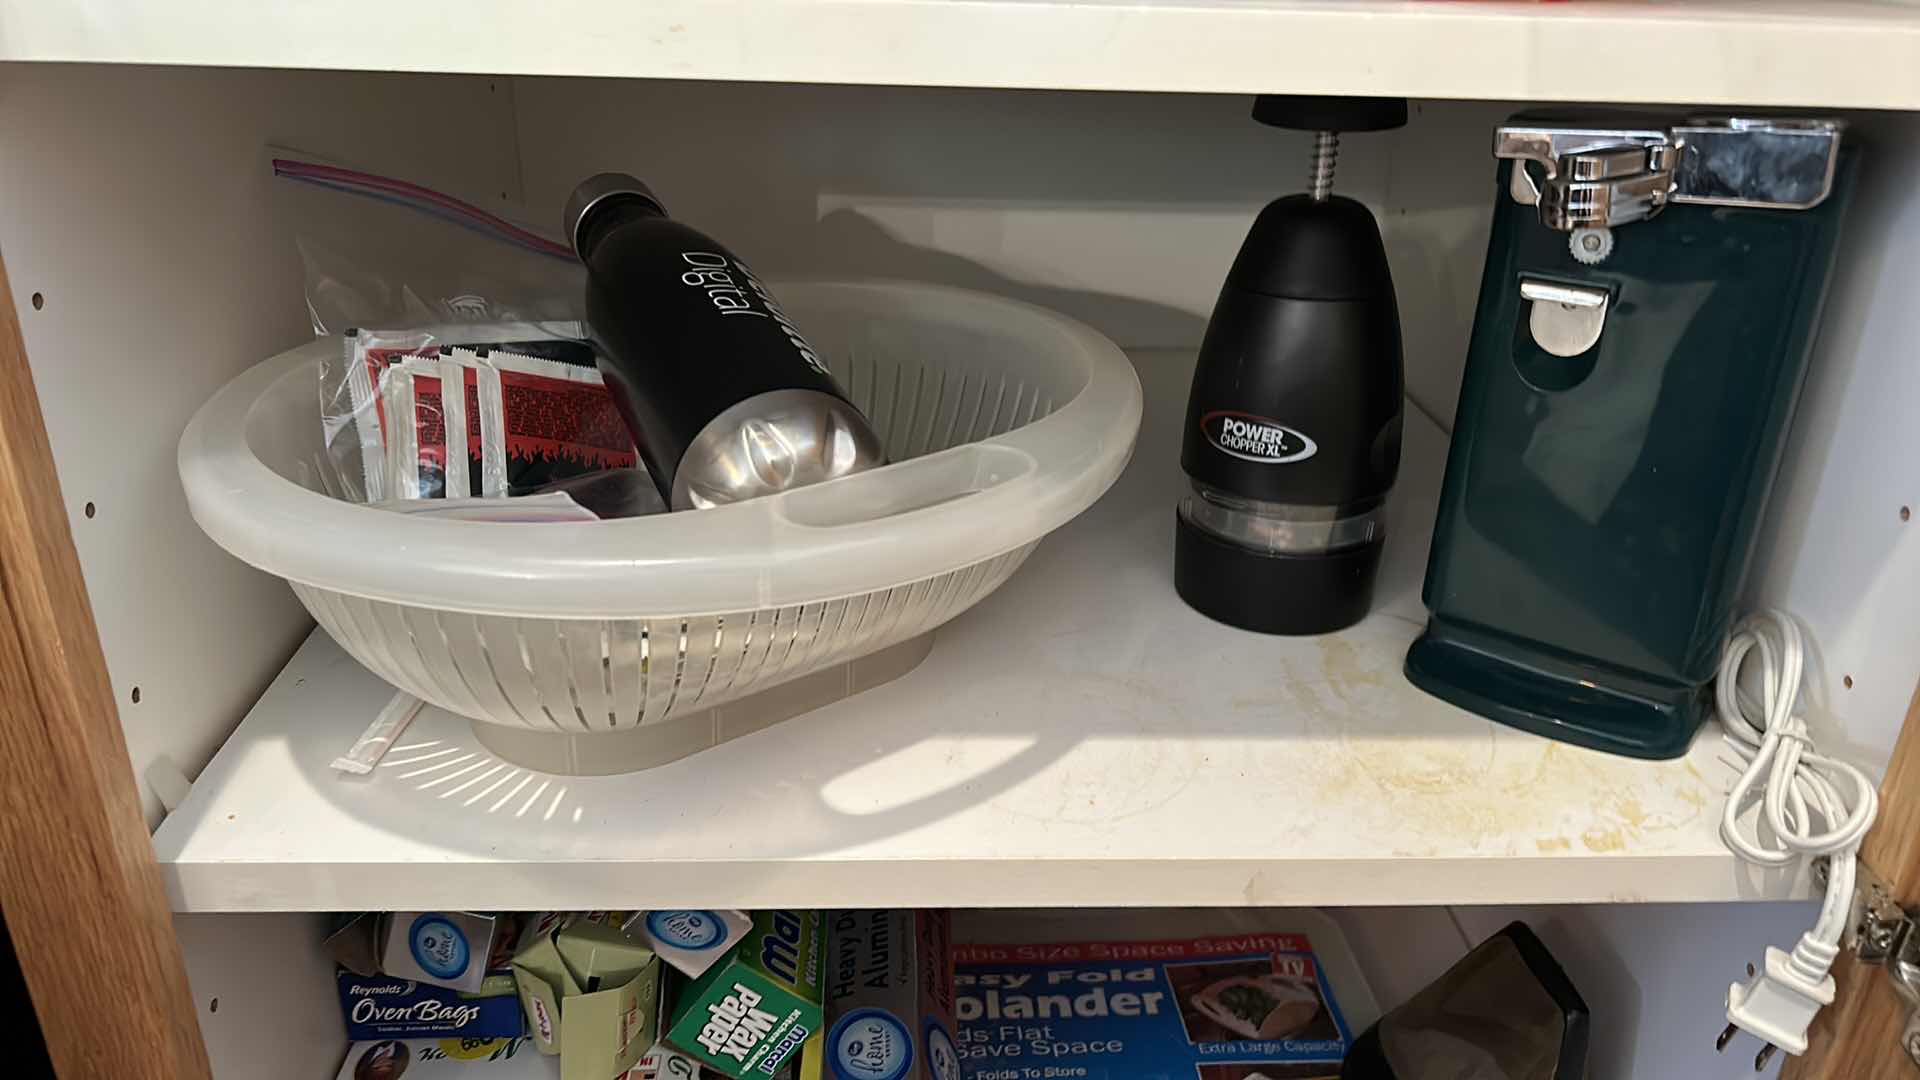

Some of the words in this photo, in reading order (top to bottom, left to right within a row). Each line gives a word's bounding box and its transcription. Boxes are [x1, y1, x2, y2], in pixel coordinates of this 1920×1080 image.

[681, 251, 769, 318] Digital
[1220, 432, 1266, 456] CHOPPER
[1222, 416, 1284, 445] POWER
[759, 911, 801, 986] Mar
[862, 910, 889, 988] Alumin
[1016, 945, 1081, 961] Size
[1089, 943, 1185, 962] Space
[835, 936, 862, 1000] Heavy
[954, 972, 1033, 990] asy
[1047, 968, 1156, 986] Fold
[349, 983, 403, 998] Reynolds
[954, 987, 1165, 1020] olander
[351, 997, 413, 1024] Oven
[413, 999, 481, 1028] Bags
[696, 982, 763, 1056] Paper
[720, 1006, 779, 1063] Wax
[999, 1025, 1056, 1042] Flat
[957, 1042, 1023, 1059] Save
[1031, 1040, 1124, 1058] Space
[975, 1068, 1019, 1080] Folds
[1023, 1067, 1042, 1079] To
